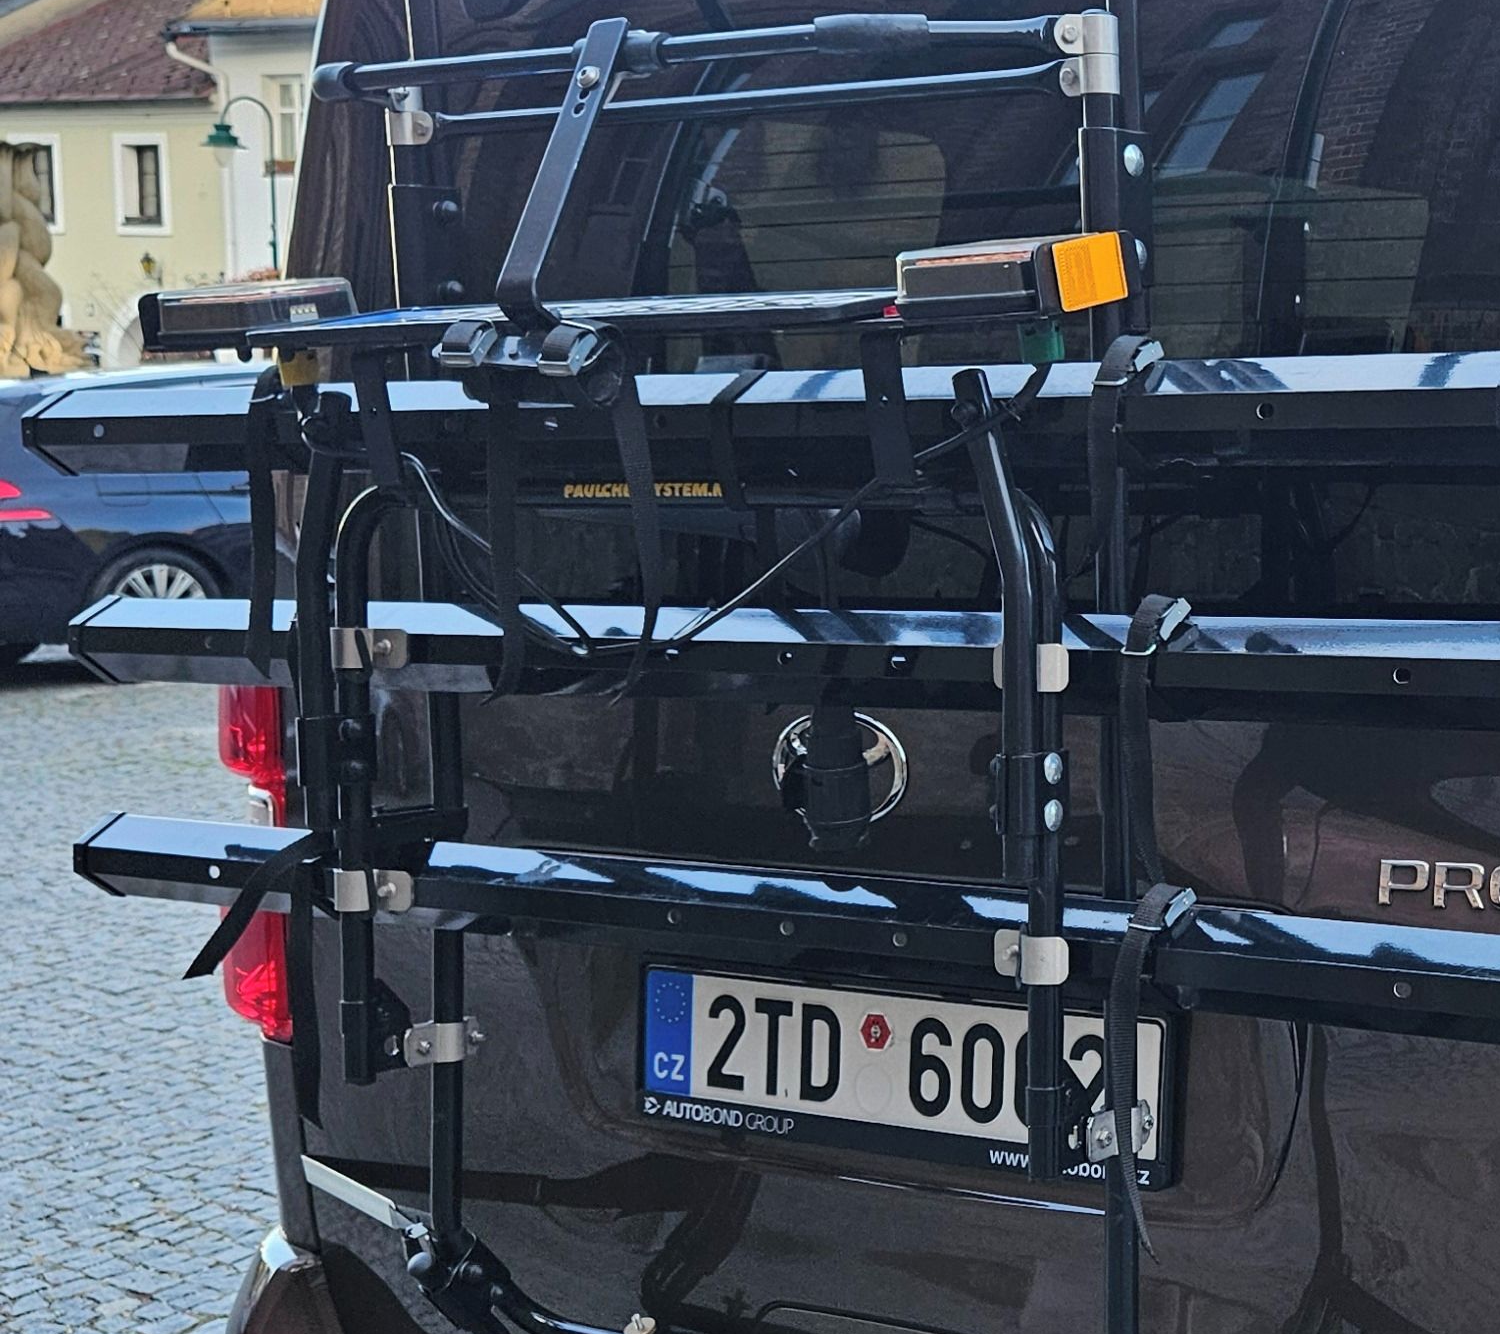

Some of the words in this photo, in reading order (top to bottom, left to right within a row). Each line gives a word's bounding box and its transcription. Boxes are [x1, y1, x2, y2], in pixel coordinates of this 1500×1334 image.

[653, 1051, 685, 1081] CZ
[706, 994, 842, 1103] 2TD
[662, 1099, 744, 1128] AUTOBOND
[744, 1112, 795, 1135] GROUP
